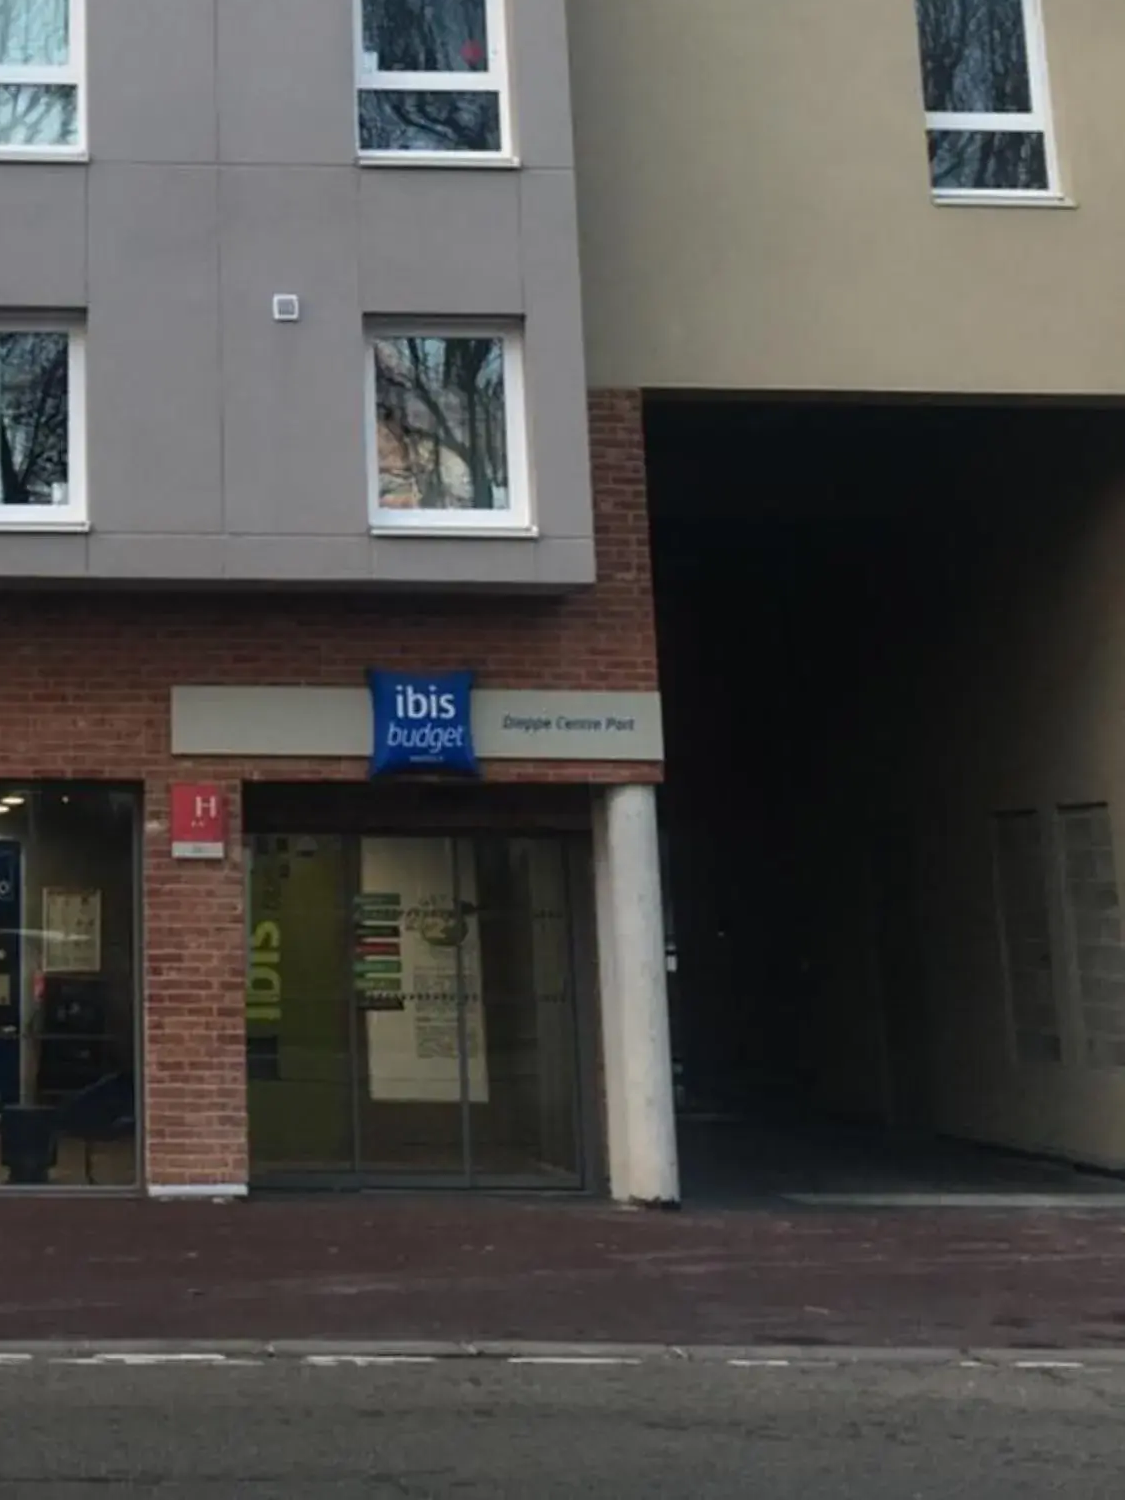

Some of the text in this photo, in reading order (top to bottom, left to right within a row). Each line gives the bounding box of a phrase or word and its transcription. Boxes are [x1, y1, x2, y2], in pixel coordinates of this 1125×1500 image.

[394, 684, 457, 720] ibis
[386, 721, 465, 754] budget
[195, 794, 218, 820] H
